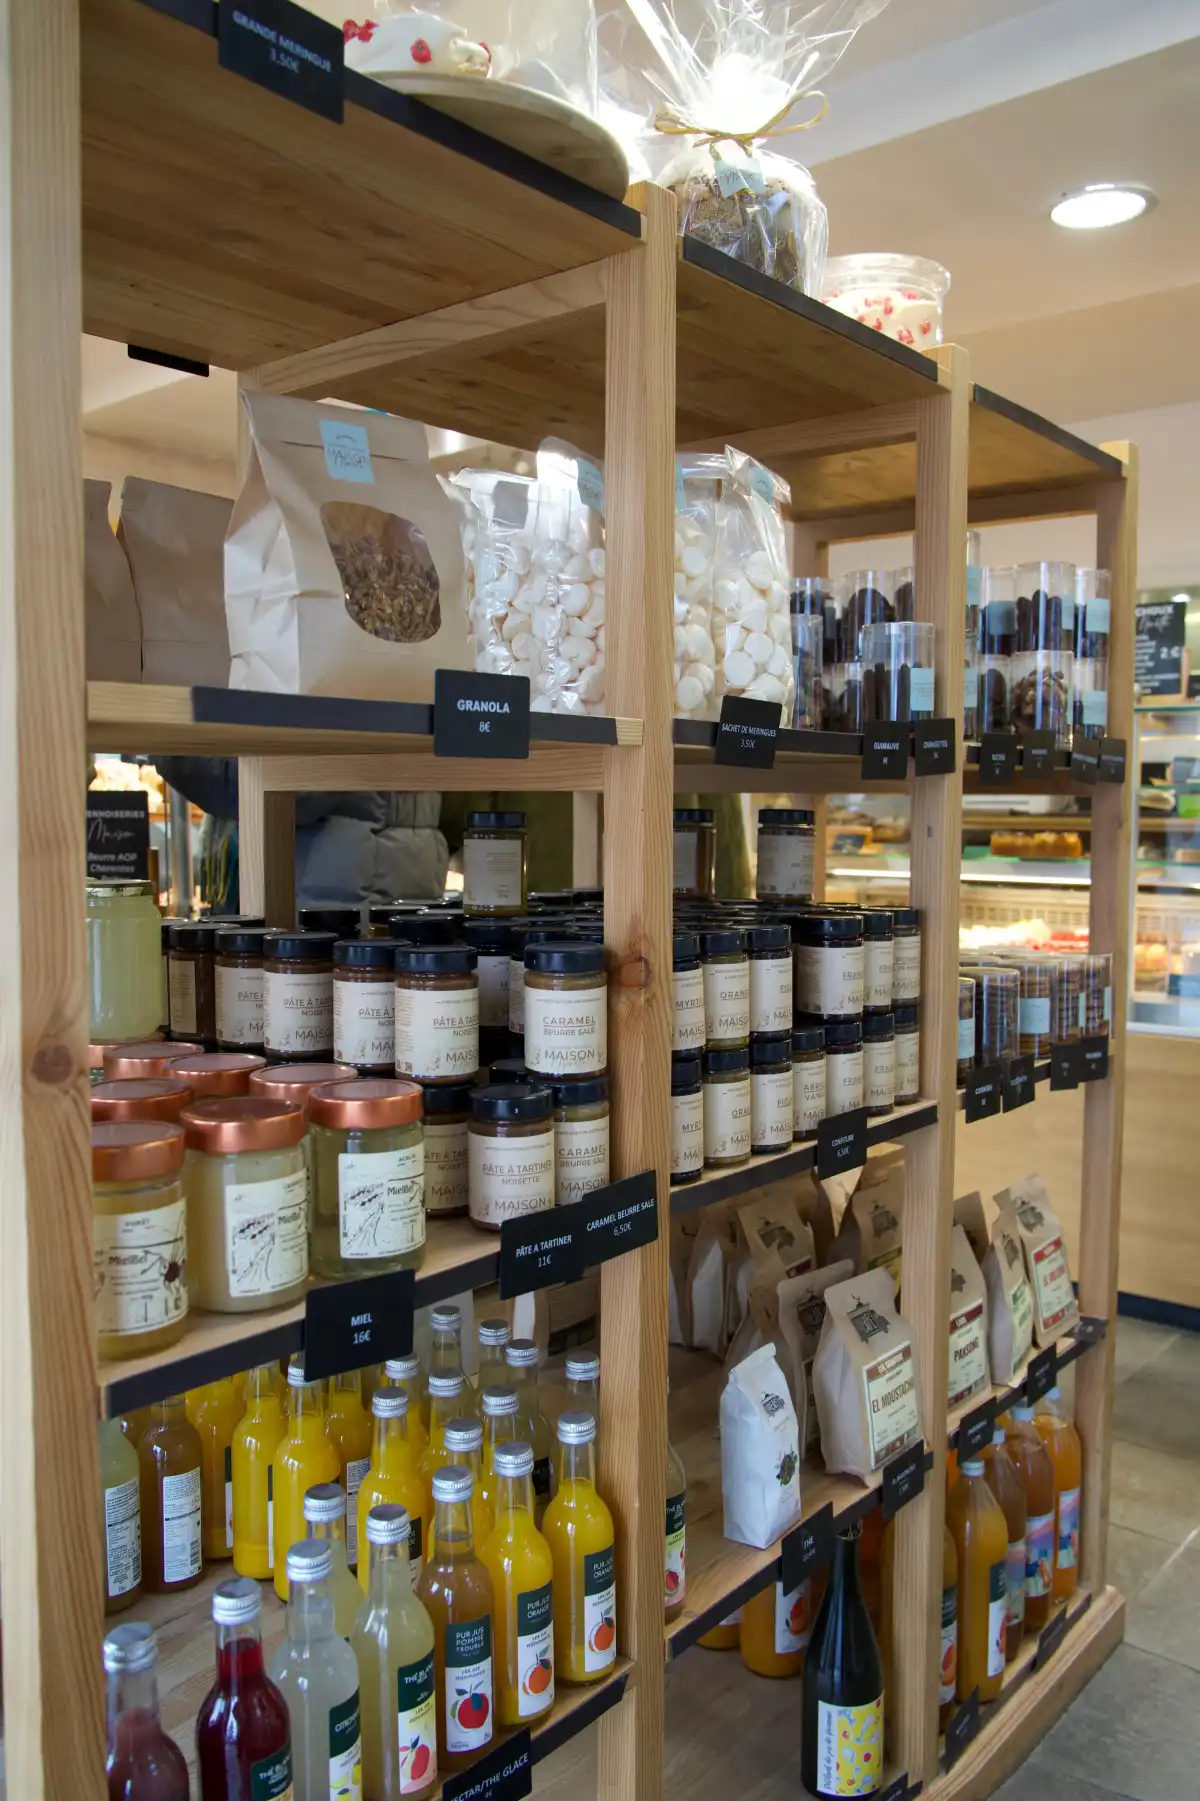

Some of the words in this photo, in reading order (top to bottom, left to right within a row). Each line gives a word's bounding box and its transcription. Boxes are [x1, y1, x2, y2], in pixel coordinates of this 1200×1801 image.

[232, 9, 277, 44] GRANDE
[279, 34, 332, 73] MERINGUE
[457, 699, 510, 713] GRANOLA
[479, 721, 491, 733] 8€
[721, 723, 741, 733] SACHET
[741, 725, 749, 734] DE
[749, 727, 777, 738] MERINGUES
[873, 742, 900, 751] GUIMAUVE
[542, 1015, 596, 1026] CARAMEL
[543, 1028, 577, 1037] BEURRE
[544, 1049, 595, 1061] MAISON
[558, 1143, 607, 1157] CARAMEL
[483, 1162, 505, 1174] PÂTE
[507, 1163, 515, 1174] À
[517, 1159, 552, 1174] TARTINER
[560, 1160, 591, 1168] BEURRE
[502, 1176, 540, 1186] NOISETTE
[560, 1177, 606, 1192] MAISON
[495, 1197, 546, 1211] MAISON
[586, 1213, 616, 1232] CARAMEL
[617, 1203, 640, 1221] BEURRE
[613, 1221, 632, 1237] 6,50€
[516, 1246, 533, 1259] PÂTE
[533, 1243, 539, 1253] A
[540, 1234, 572, 1250] TARTINER
[537, 1254, 552, 1268] 11€
[350, 1312, 373, 1327] MIEL
[353, 1329, 371, 1345] 16€
[871, 1398, 881, 1413] EL
[527, 1599, 541, 1610] PUR
[456, 1631, 471, 1640] PUR
[472, 1626, 484, 1637] JUS
[456, 1634, 485, 1647] POMME
[456, 1641, 485, 1653] TROUBLE
[502, 1752, 529, 1778] GLACE
